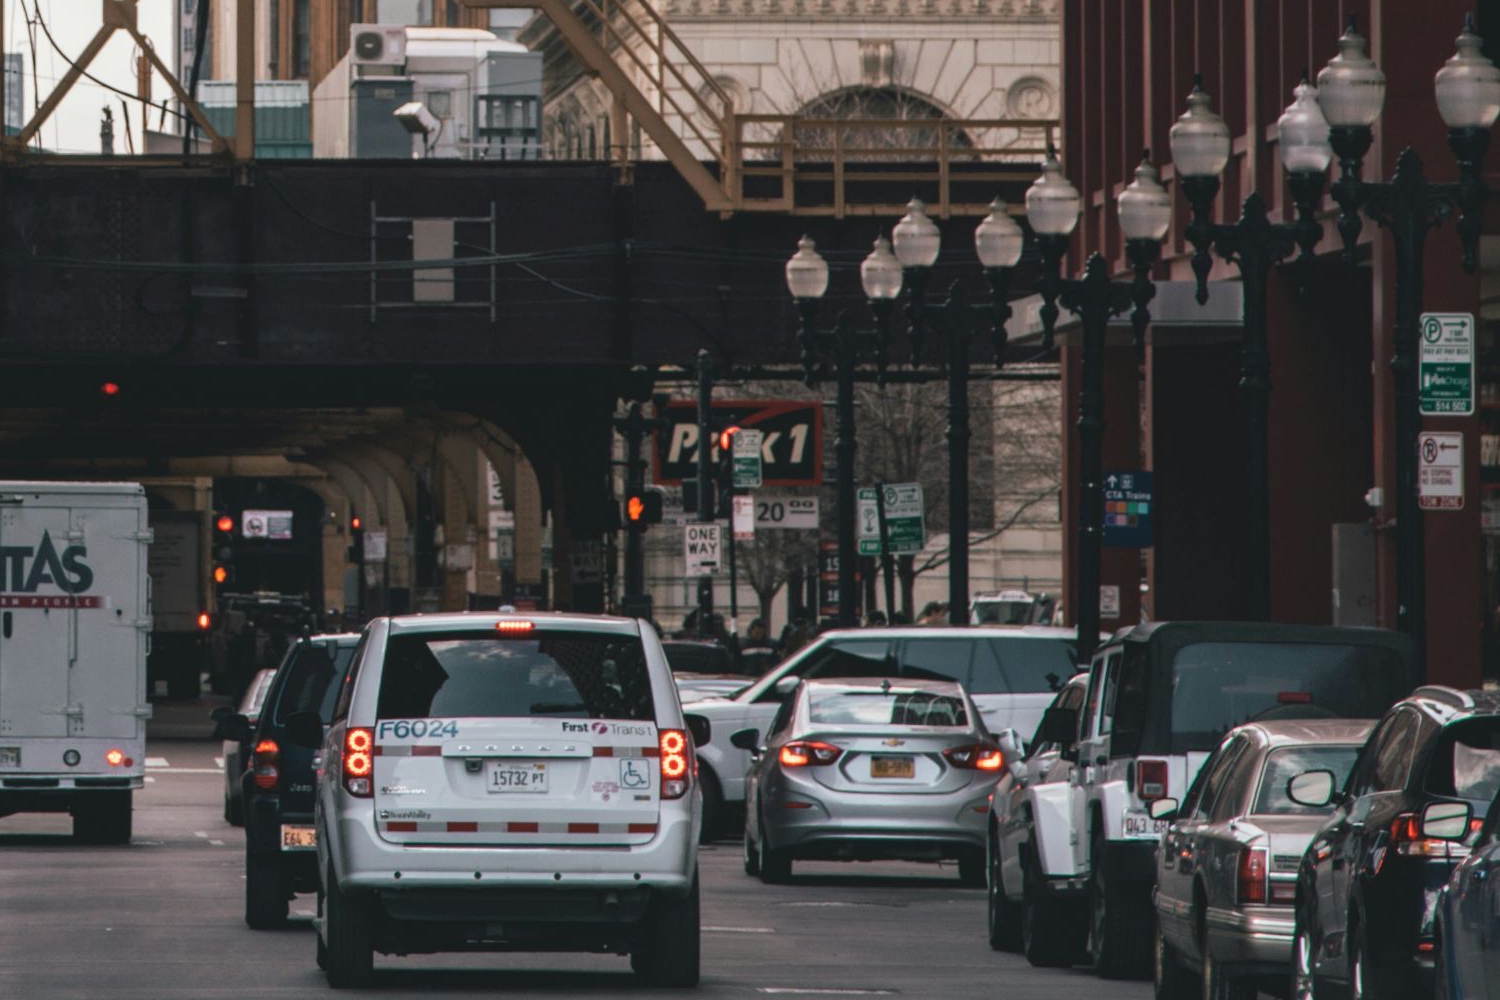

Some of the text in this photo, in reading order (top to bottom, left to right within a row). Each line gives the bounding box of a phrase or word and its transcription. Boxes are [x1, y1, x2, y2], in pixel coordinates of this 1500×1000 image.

[789, 423, 809, 464] 1
[1105, 490, 1151, 500] CTA Trains
[757, 502, 785, 522] 20
[688, 527, 717, 540] ONE
[687, 542, 718, 555] WAY
[31, 598, 92, 607] PEOPLE
[379, 720, 459, 740] F6024
[562, 721, 653, 737] First Transt
[492, 770, 545, 787] 15732 PT
[290, 783, 313, 794] Jeep
